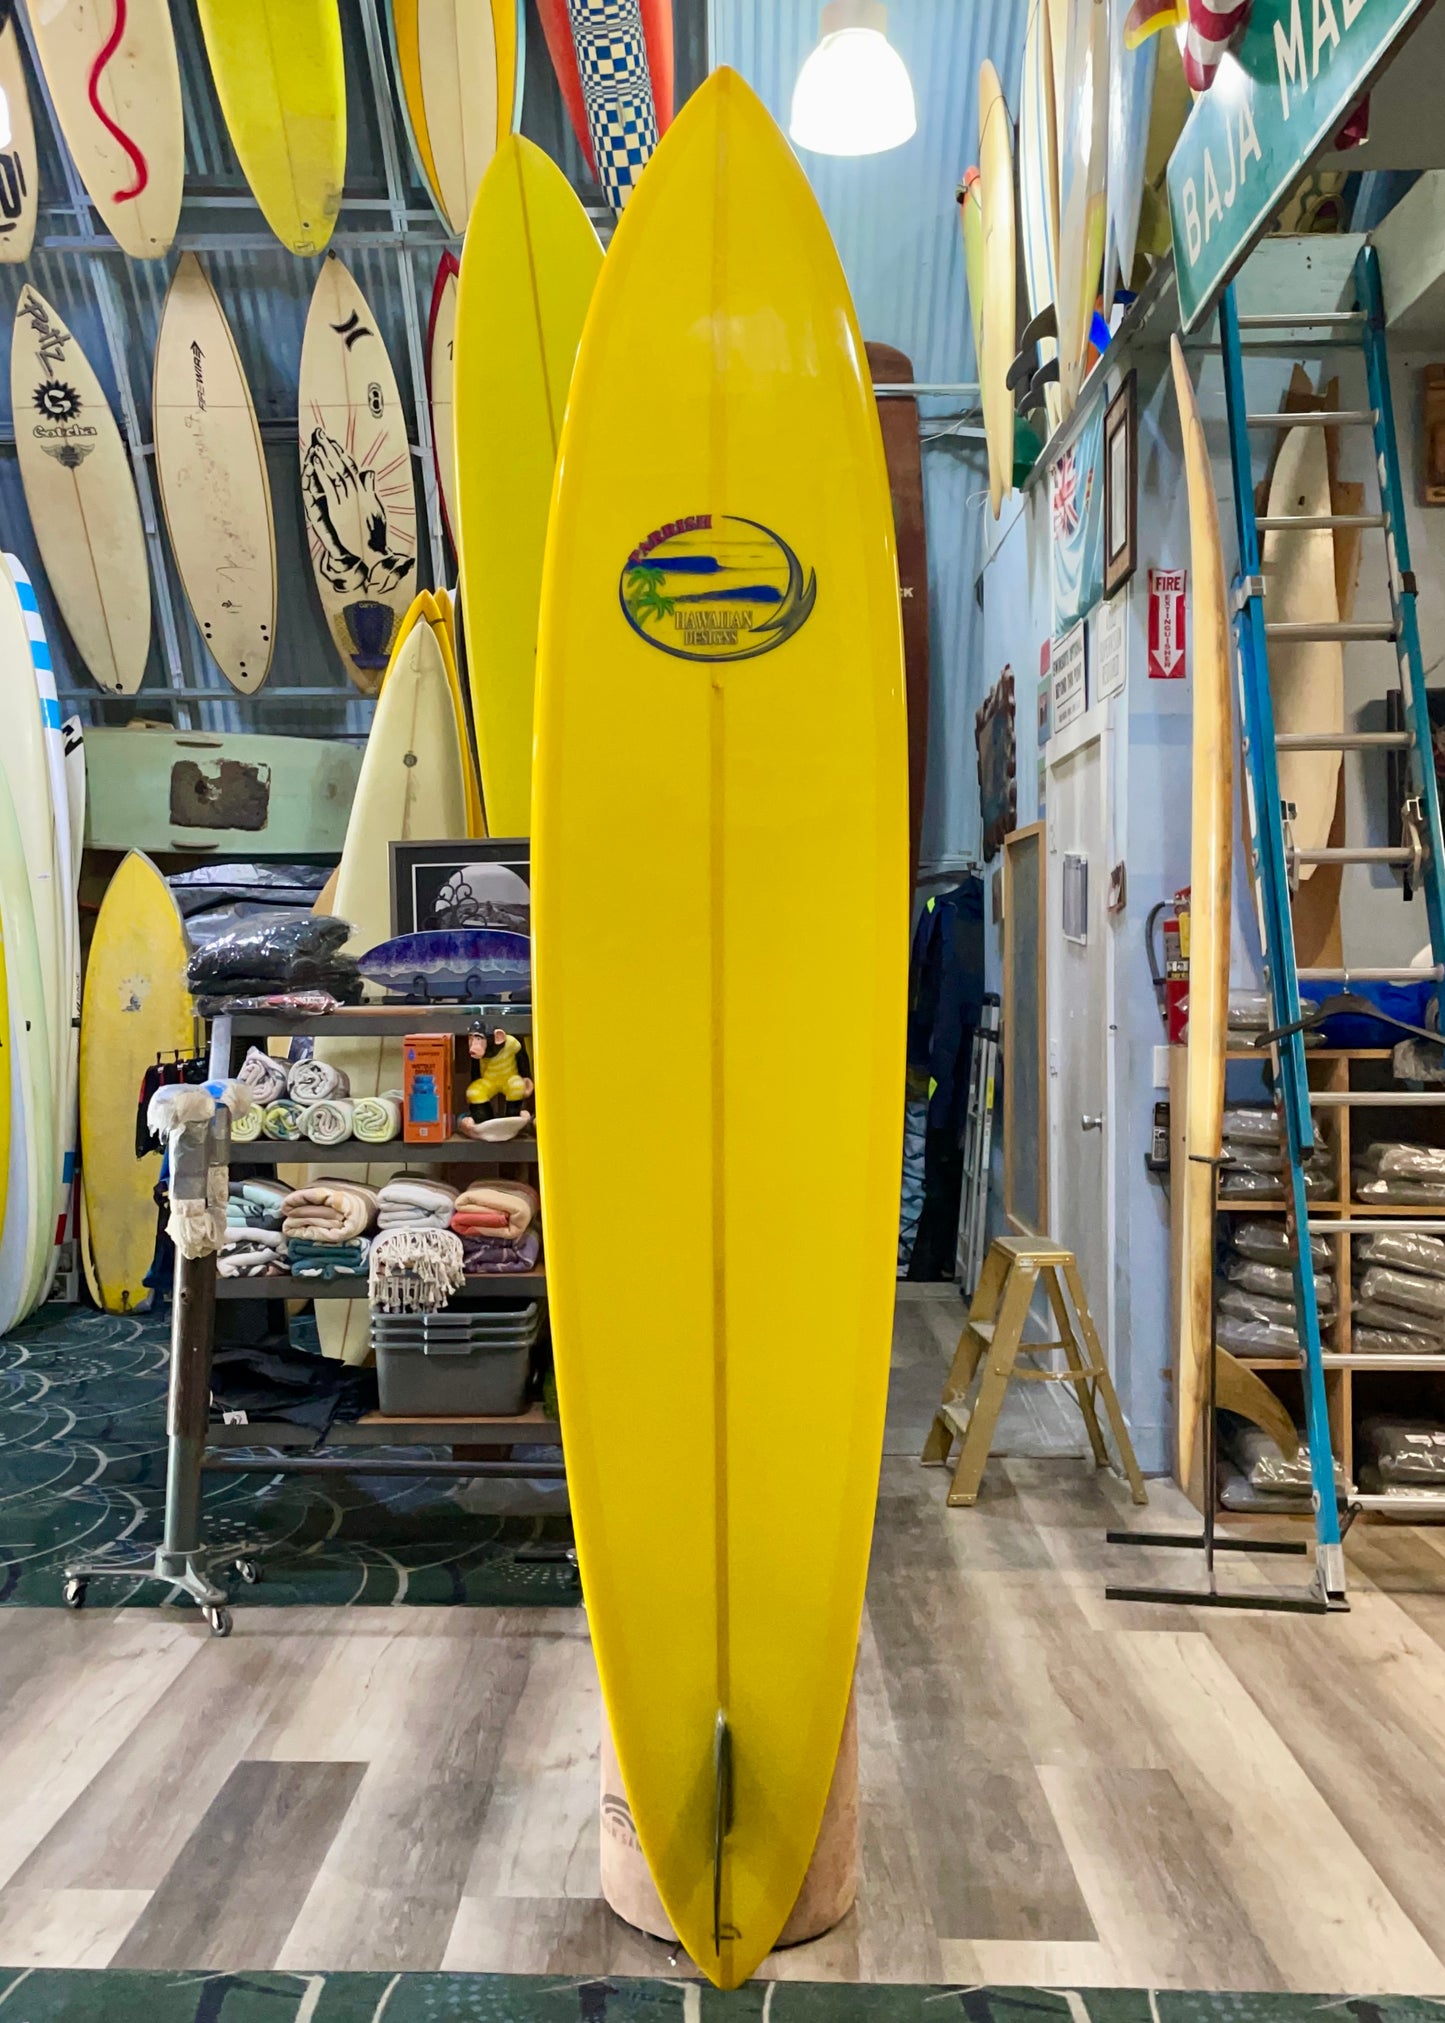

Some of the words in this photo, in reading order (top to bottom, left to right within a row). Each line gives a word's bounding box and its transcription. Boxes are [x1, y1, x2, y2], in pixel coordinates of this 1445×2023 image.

[1182, 102, 1262, 267] BAJA
[33, 423, 98, 438] Gotcha
[628, 513, 712, 563] PARRISH
[1156, 577, 1181, 591] FIRE
[675, 611, 753, 630] HAWAIIAN
[684, 630, 739, 645] DESIGNS
